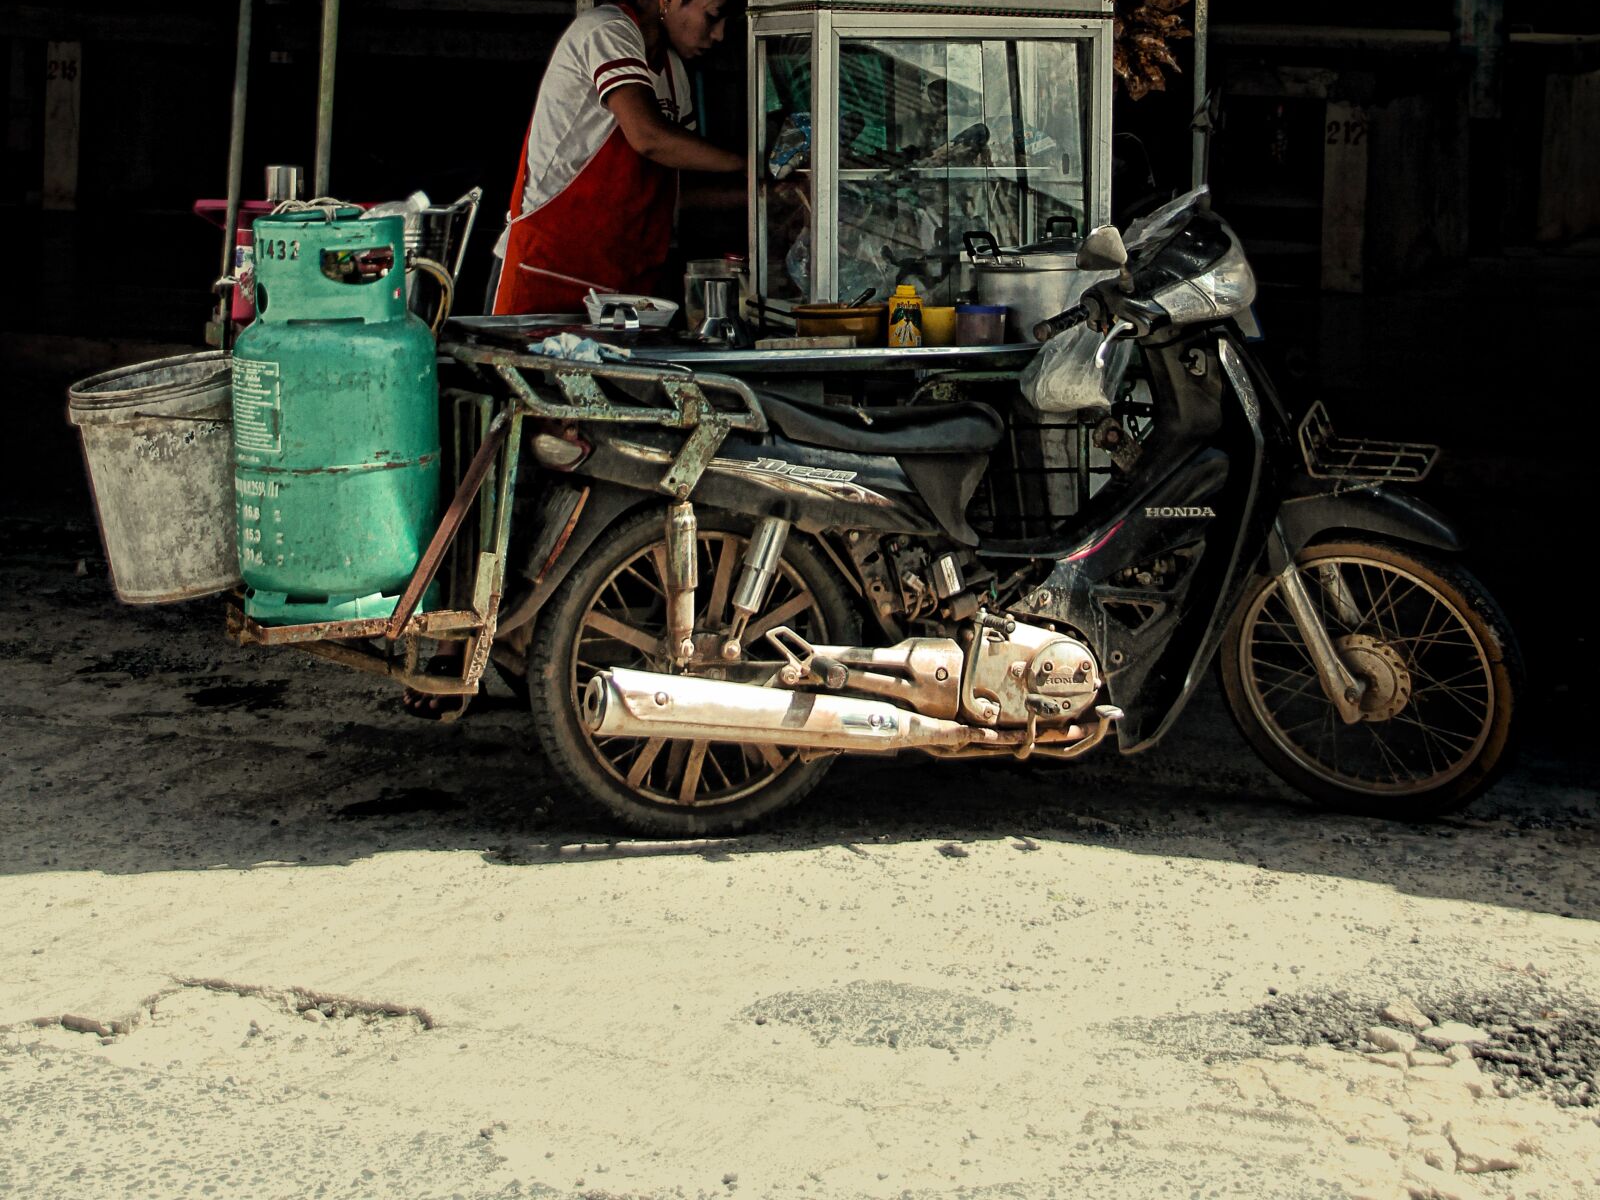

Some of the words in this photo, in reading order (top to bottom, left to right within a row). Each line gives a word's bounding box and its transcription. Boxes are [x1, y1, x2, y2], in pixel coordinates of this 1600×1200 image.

[1327, 120, 1365, 145] 217
[746, 456, 858, 482] Dream
[1145, 506, 1217, 518] HONDA
